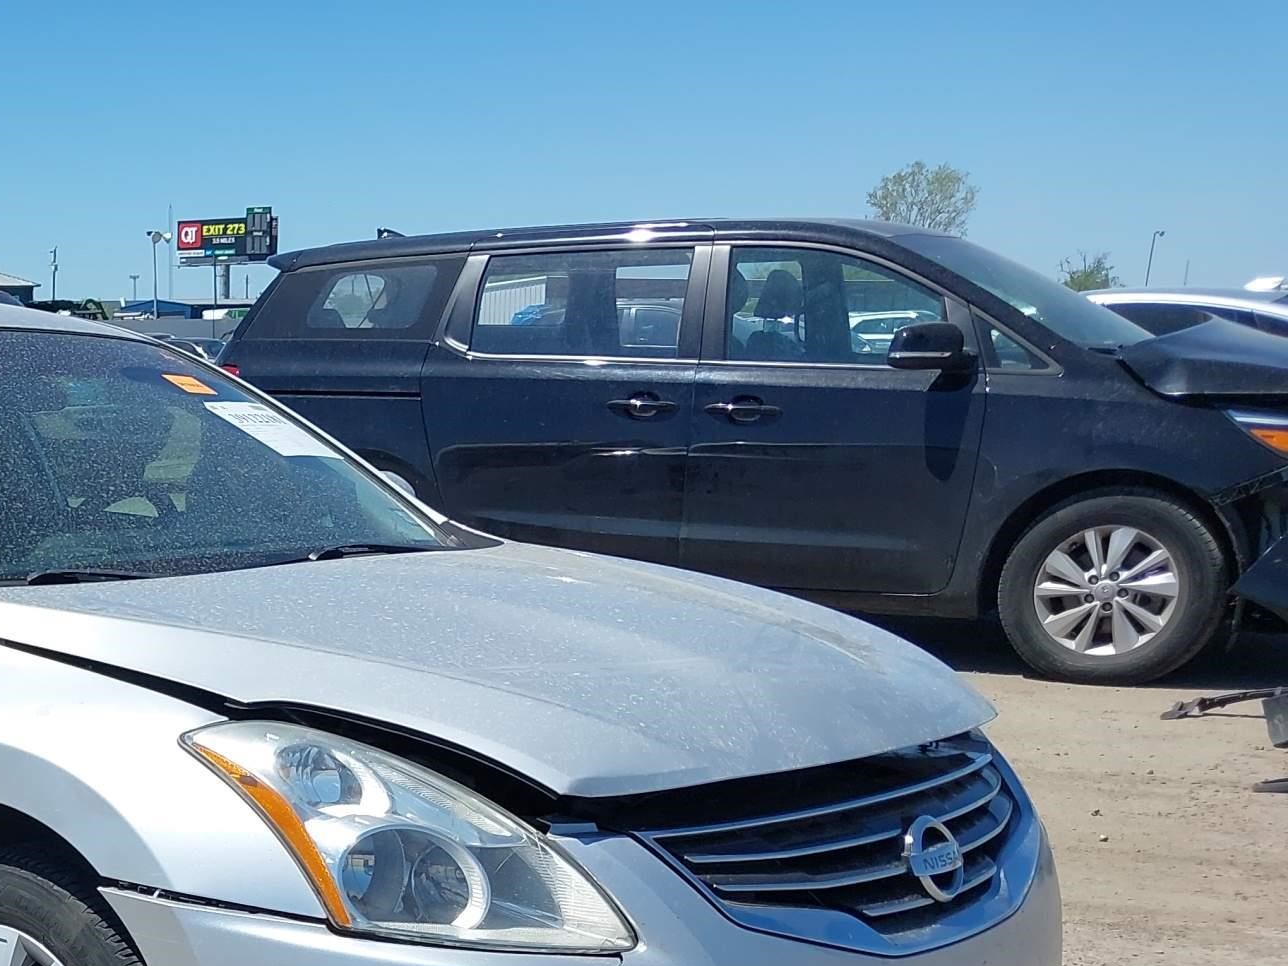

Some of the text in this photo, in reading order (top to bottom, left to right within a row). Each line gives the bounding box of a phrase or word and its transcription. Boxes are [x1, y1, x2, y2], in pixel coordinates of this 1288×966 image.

[181, 226, 198, 244] QT
[202, 224, 224, 236] EXIT
[226, 223, 245, 235] 273
[923, 851, 957, 870] NISS
